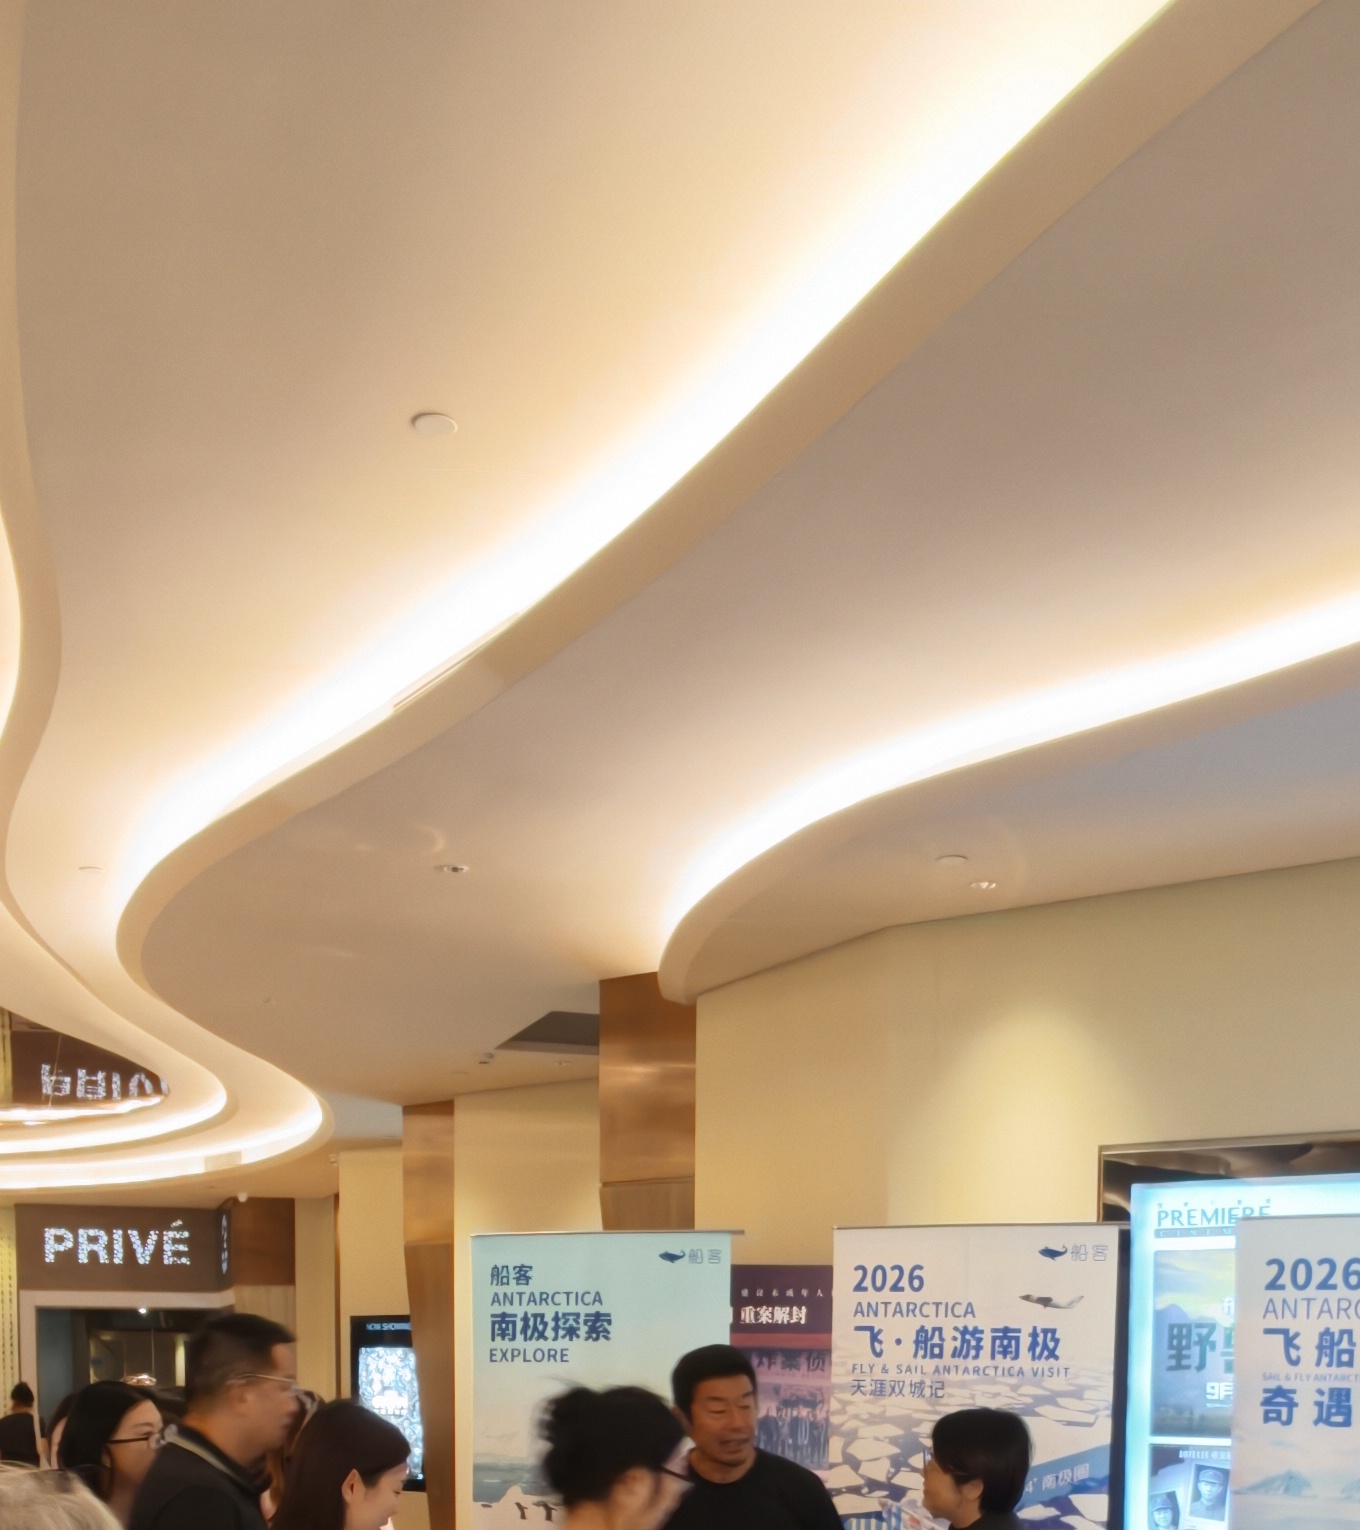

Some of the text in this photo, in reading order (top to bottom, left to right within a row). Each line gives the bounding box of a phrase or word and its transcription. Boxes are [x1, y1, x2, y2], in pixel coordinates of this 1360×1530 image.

[44, 1218, 191, 1266] PRIVÉ
[1071, 1244, 1109, 1262] 船客
[490, 1264, 533, 1286] 船客
[852, 1264, 925, 1292] 2026
[491, 1291, 603, 1307] ANTARCTICA
[853, 1302, 976, 1318] ANTARCTICA
[490, 1310, 613, 1342] 南极探索
[489, 1348, 570, 1363] EXPLORE
[1166, 1322, 1234, 1373] 野
[851, 1363, 1071, 1378] FLY & SAIL ANTARCTICA VISIT
[1293, 1373, 1313, 1384] FLY
[850, 1379, 946, 1399] 天涯双城记
